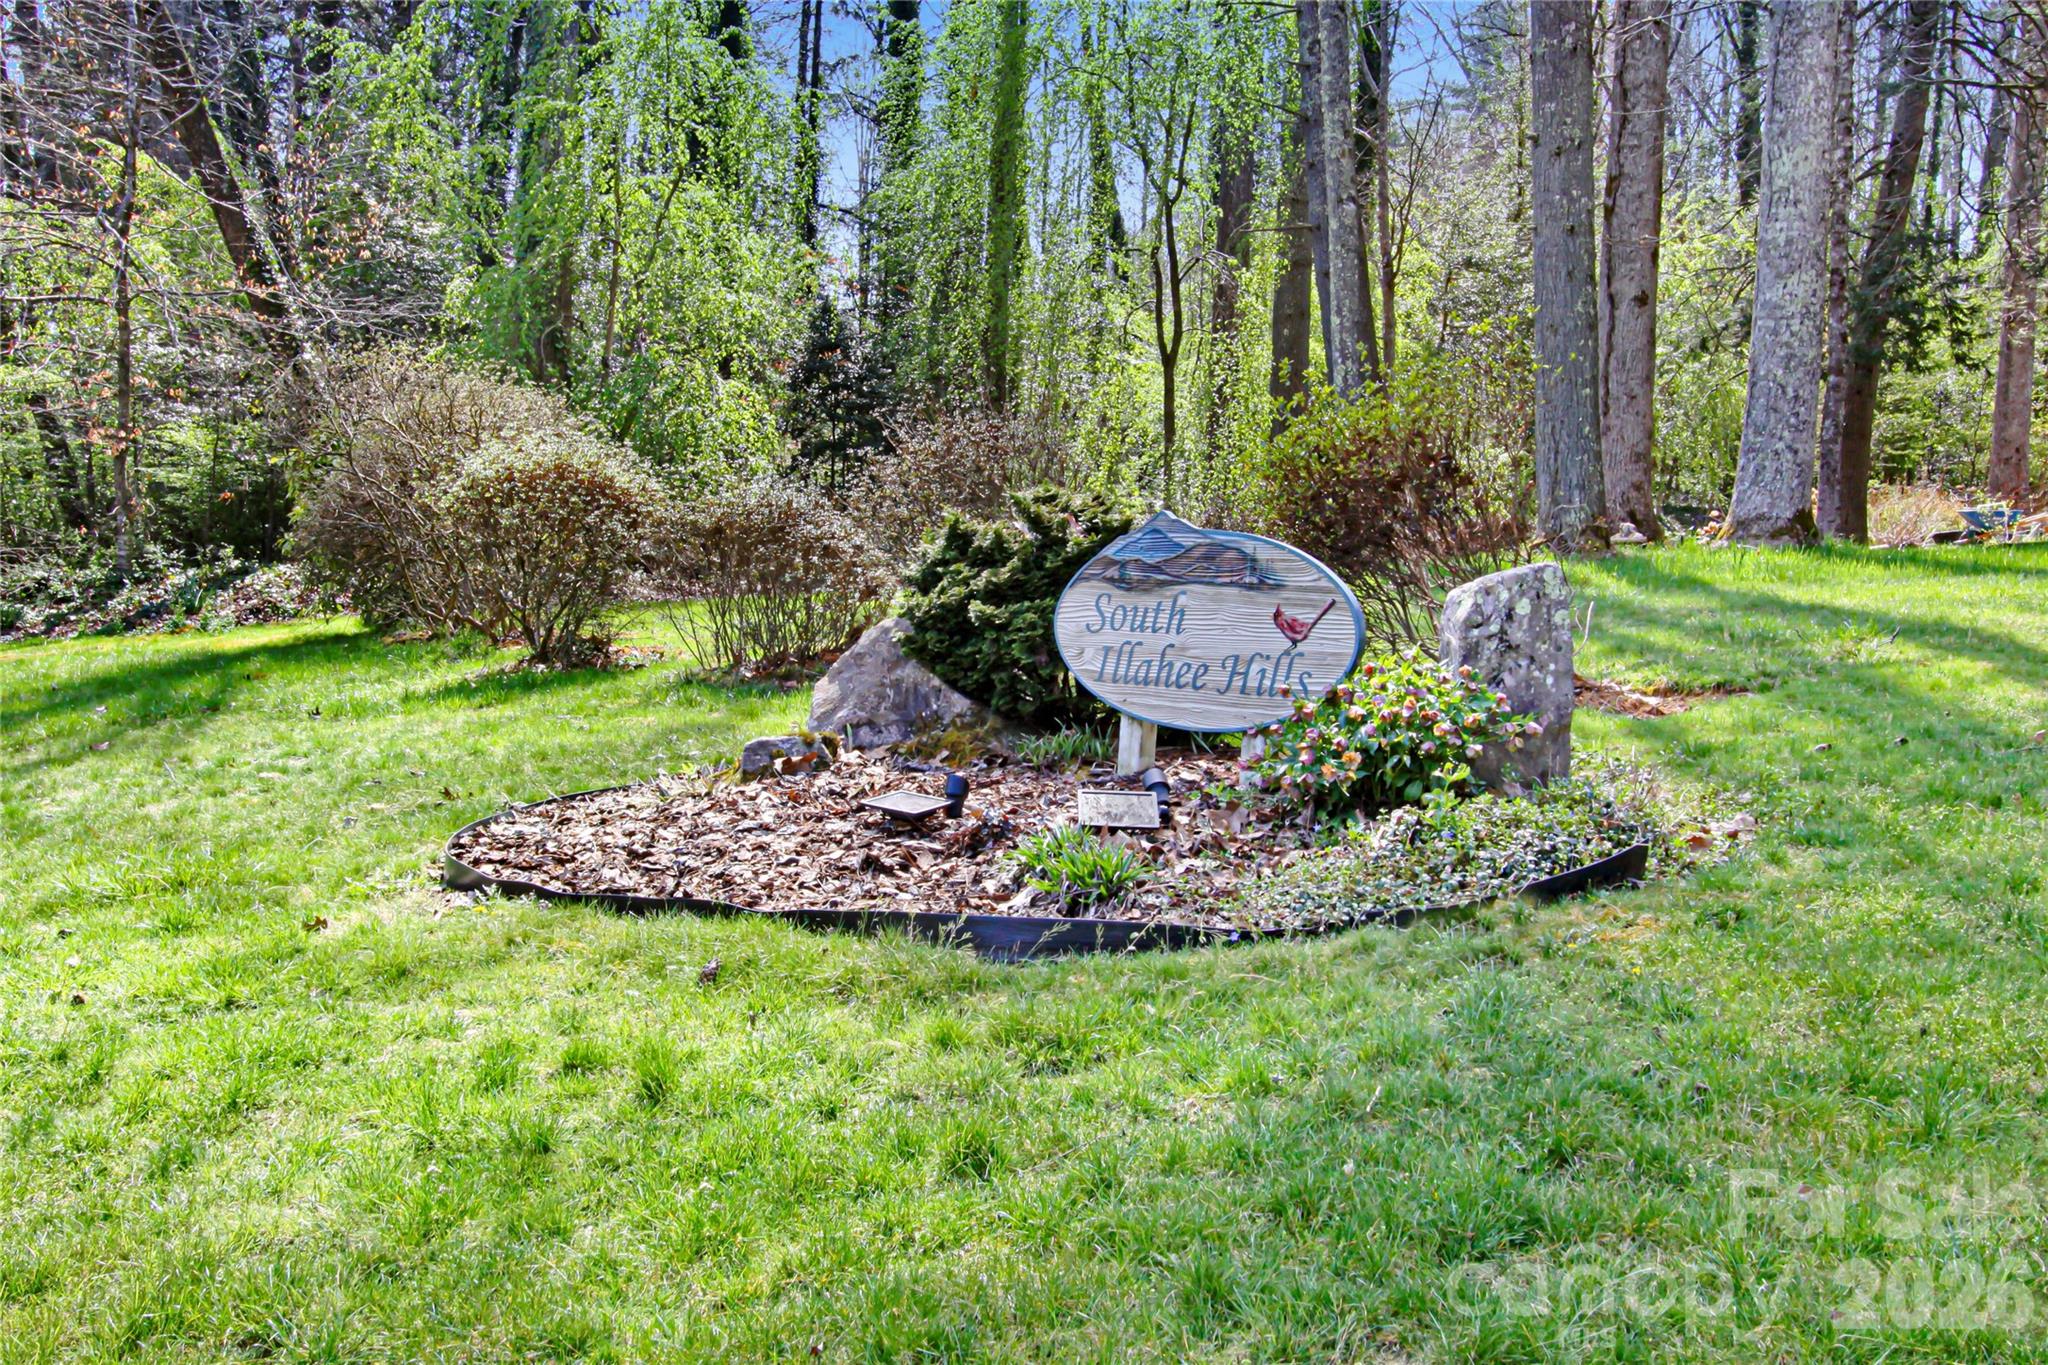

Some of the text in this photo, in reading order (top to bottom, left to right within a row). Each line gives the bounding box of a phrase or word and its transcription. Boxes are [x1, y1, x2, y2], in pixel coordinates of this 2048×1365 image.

[1086, 590, 1187, 635] South
[1094, 640, 1313, 701] Illahee Hills
